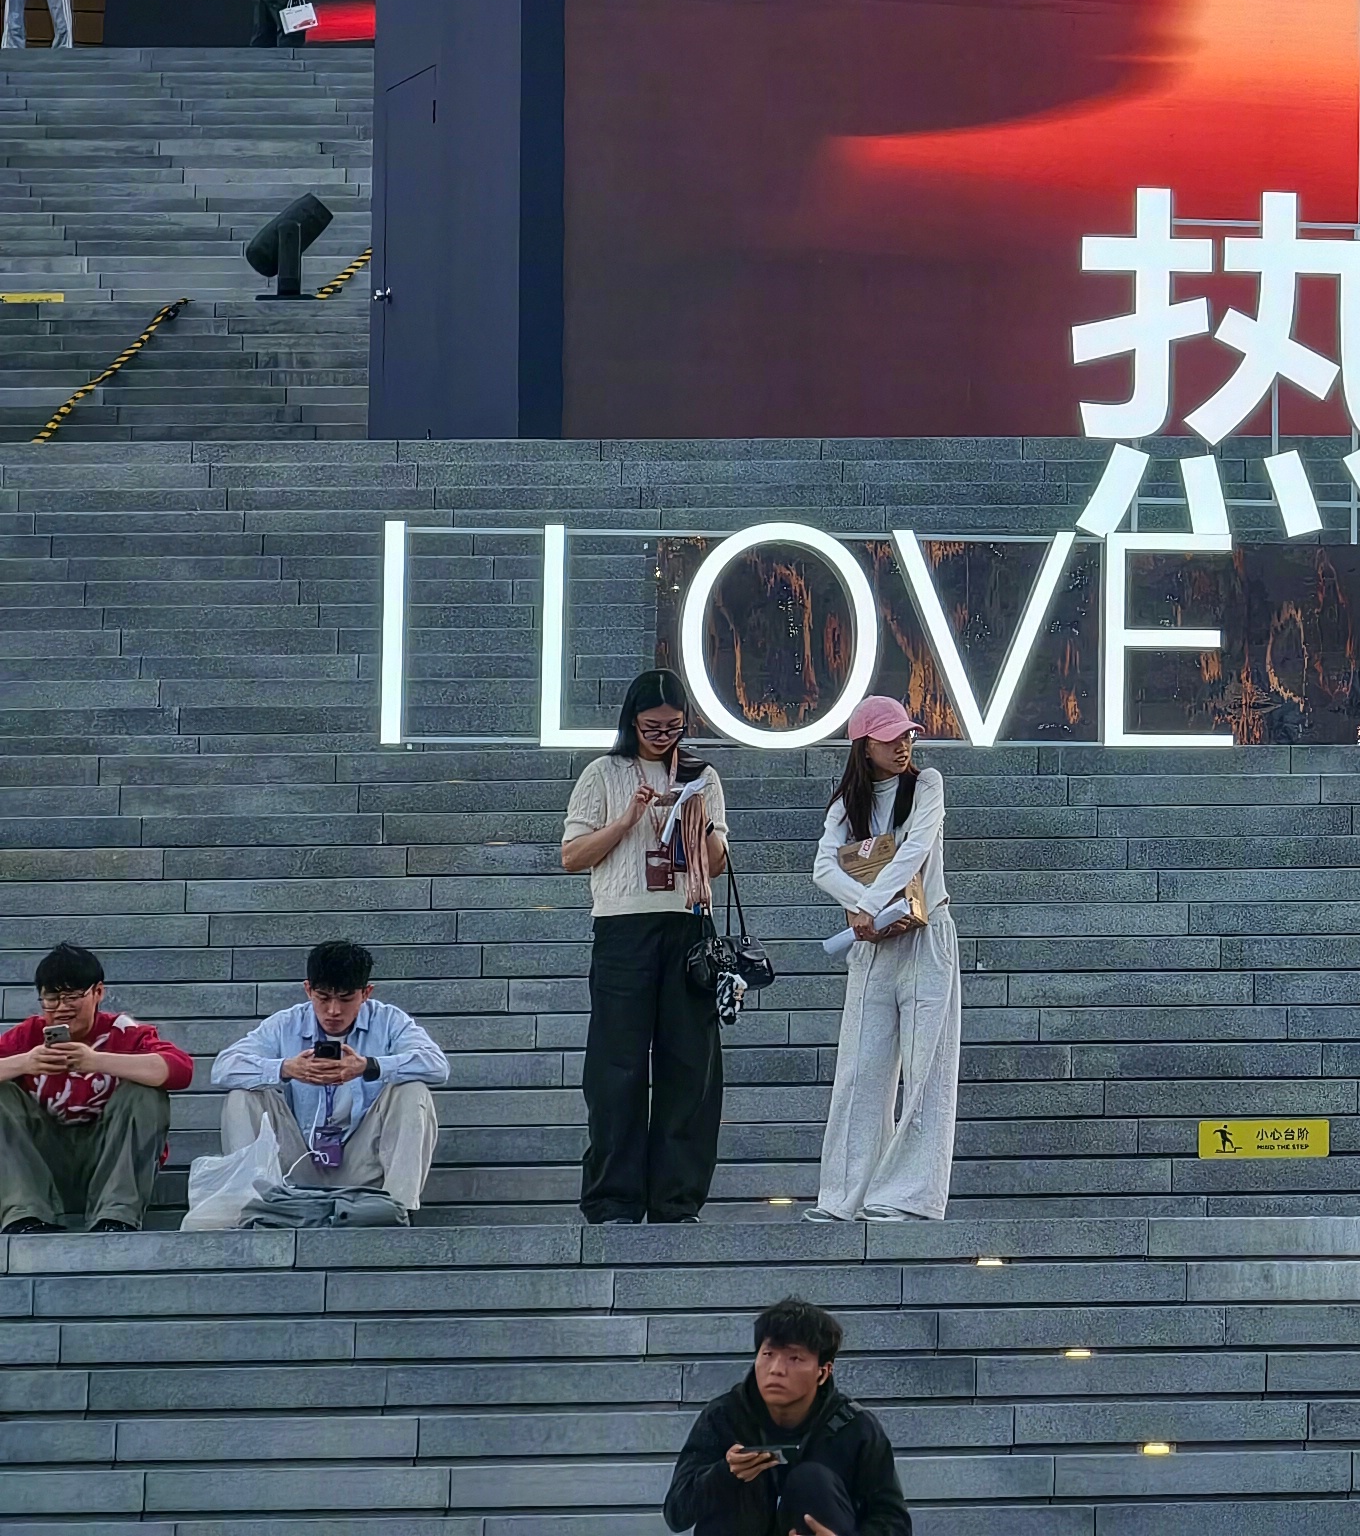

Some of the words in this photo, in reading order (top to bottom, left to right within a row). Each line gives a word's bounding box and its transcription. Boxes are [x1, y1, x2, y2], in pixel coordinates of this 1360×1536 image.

[380, 520, 407, 745] I
[539, 521, 1234, 752] LOVE
[1255, 1127, 1310, 1141] 小心台阶
